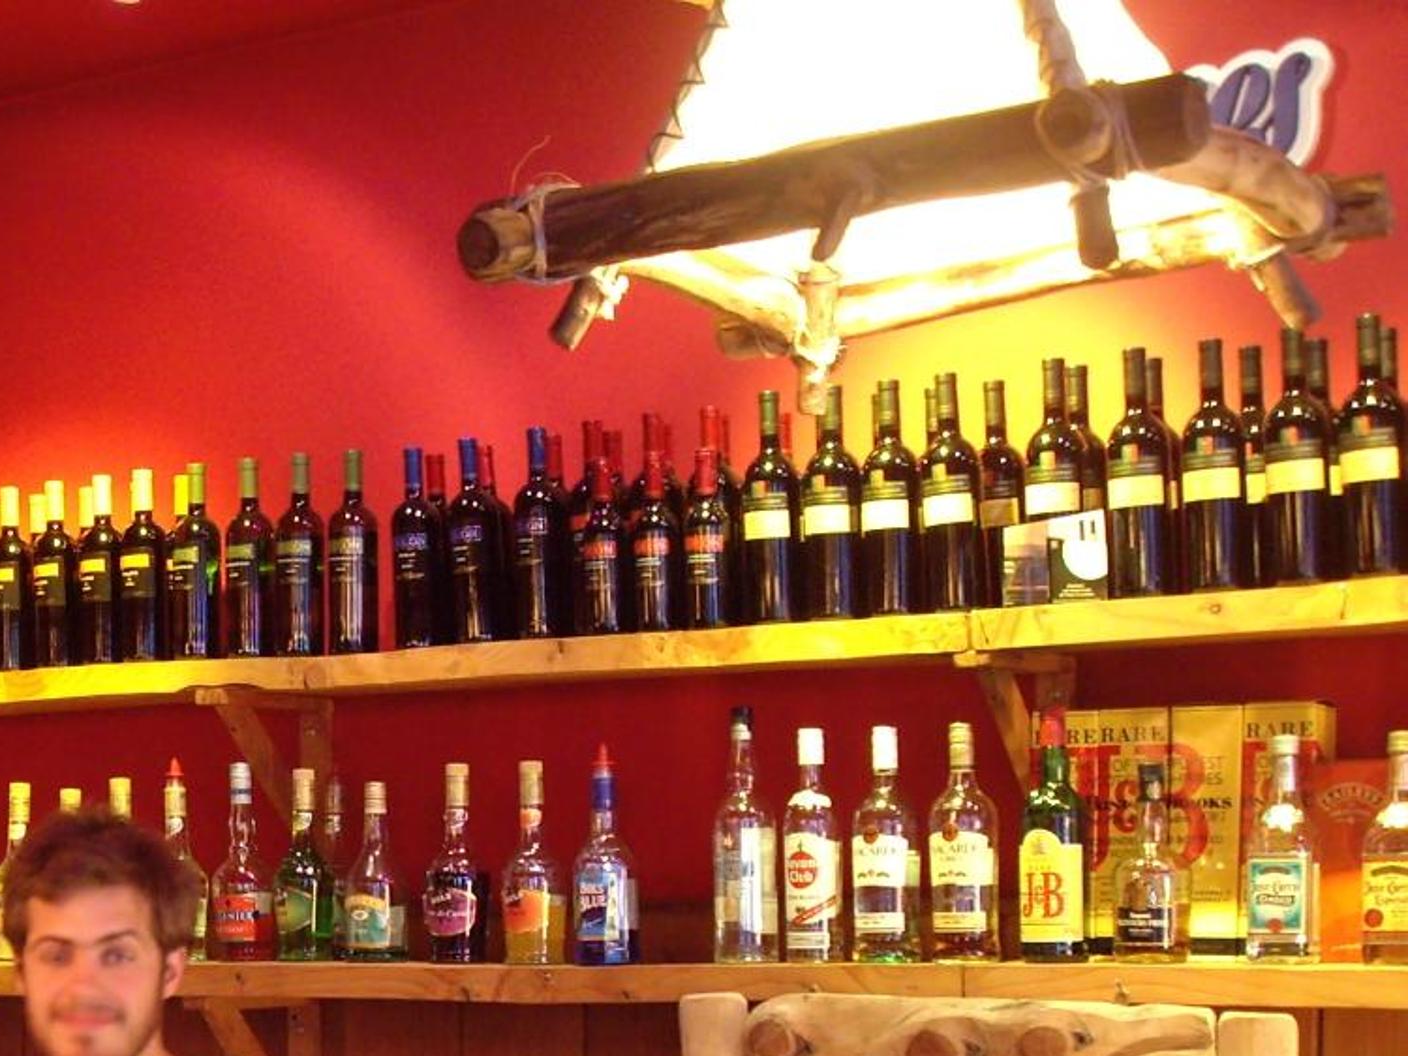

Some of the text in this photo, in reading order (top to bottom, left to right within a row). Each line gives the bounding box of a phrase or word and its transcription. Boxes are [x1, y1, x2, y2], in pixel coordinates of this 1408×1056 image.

[1100, 722, 1166, 743] RARE
[1246, 720, 1314, 738] RARE
[1022, 872, 1065, 918] J&B
